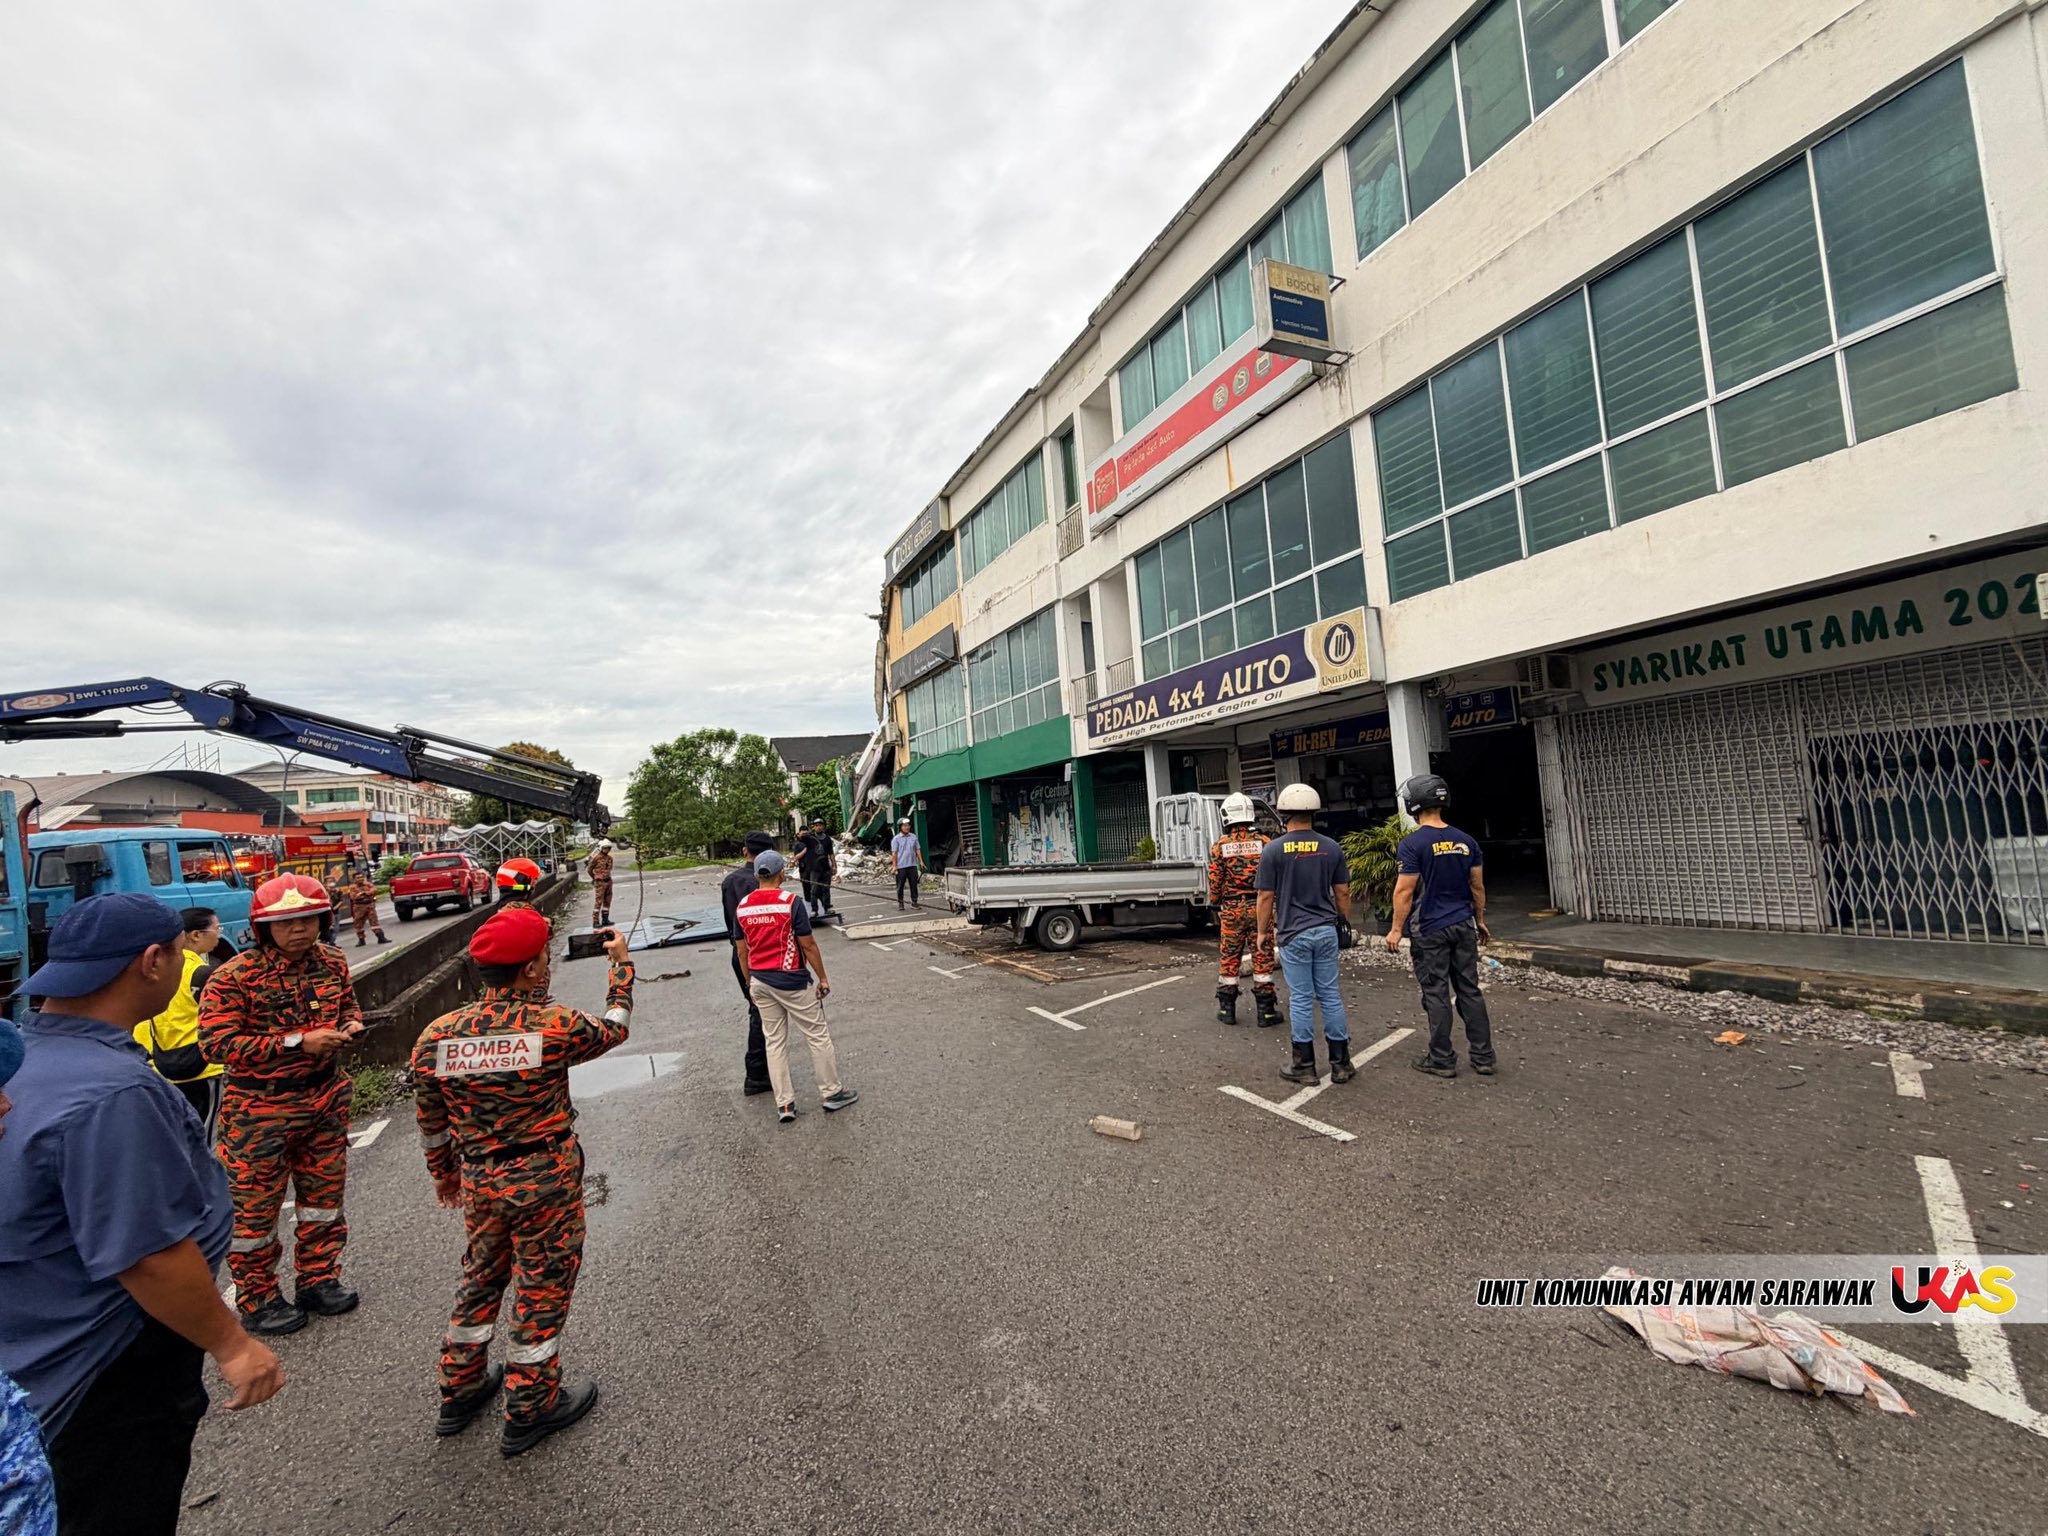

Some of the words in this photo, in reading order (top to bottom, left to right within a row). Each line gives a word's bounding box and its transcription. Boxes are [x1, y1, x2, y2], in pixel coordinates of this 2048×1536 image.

[1286, 278, 1320, 295] BOSCH
[1159, 430, 1175, 447] Auto
[1593, 634, 1747, 693] SYARIKAT
[1764, 599, 1924, 660] UTAMA
[76, 684, 149, 700] SWL11000KG
[1096, 695, 1160, 734] PEDADA
[1168, 680, 1205, 713] 4x4
[1216, 653, 1291, 700] AUTO
[1102, 732, 1123, 744] Extra
[1126, 727, 1146, 738] High
[1150, 710, 1212, 732] Performance
[1218, 698, 1258, 714] Engine
[1264, 690, 1283, 702] Oil
[1451, 708, 1496, 728] AUTO
[1293, 728, 1337, 753] HI-REV
[1357, 727, 1391, 744] PEDA
[1044, 782, 1070, 798] Central
[1283, 841, 1319, 854] HI-REV
[746, 916, 776, 925] BOMBA
[446, 1038, 530, 1060] BOMBA
[445, 1056, 529, 1072] MALAYSIA
